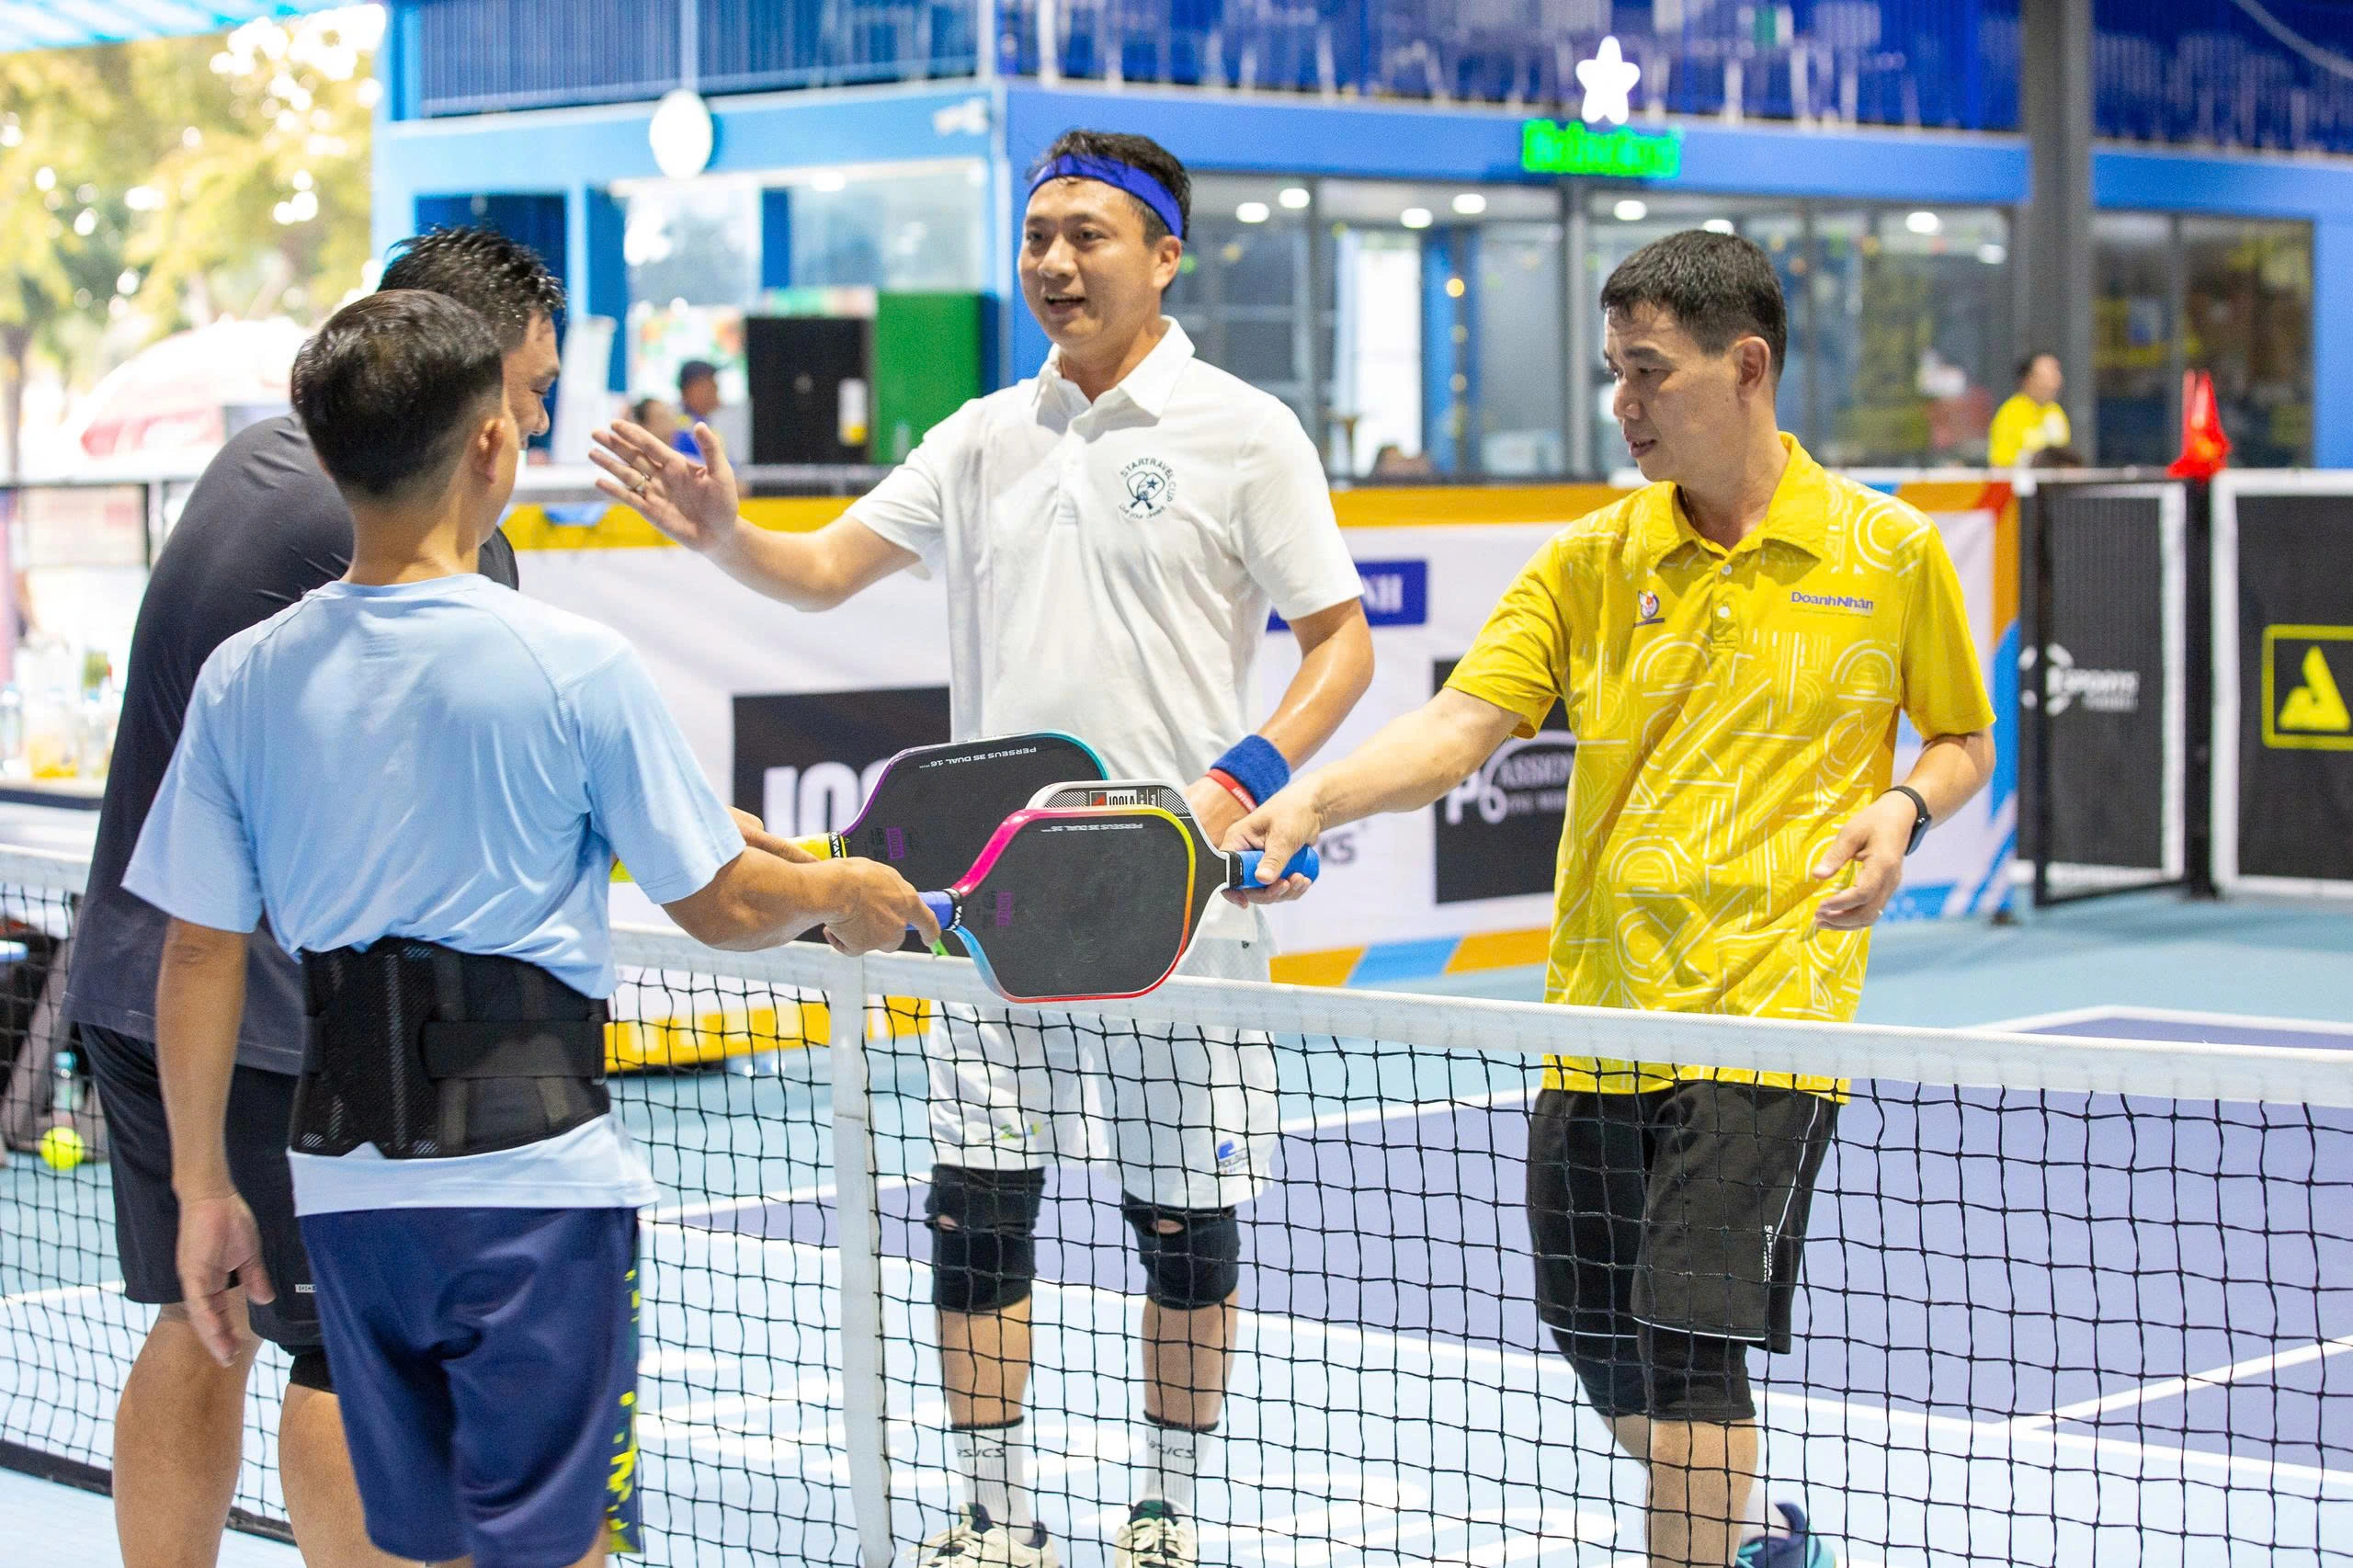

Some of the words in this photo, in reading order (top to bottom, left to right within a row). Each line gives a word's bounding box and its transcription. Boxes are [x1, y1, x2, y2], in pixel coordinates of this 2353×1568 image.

[1120, 458, 1174, 480] STARTRAVEL
[1165, 481, 1176, 502] CUP
[987, 746, 1038, 758] PERSEUS
[945, 756, 972, 766] DUAL
